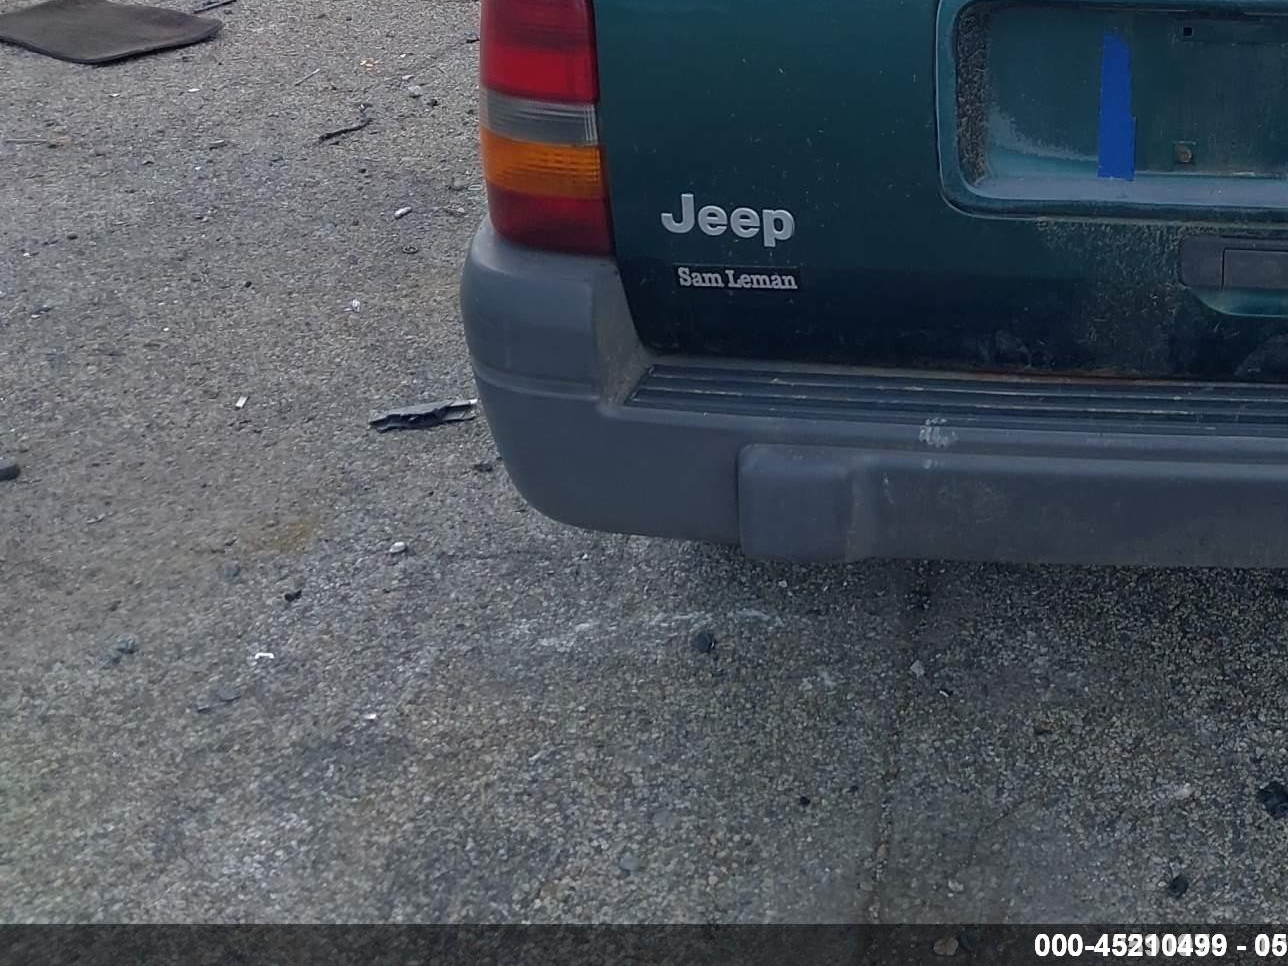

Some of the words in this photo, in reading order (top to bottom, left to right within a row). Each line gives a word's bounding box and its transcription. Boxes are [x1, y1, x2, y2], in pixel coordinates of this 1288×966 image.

[660, 193, 795, 247] Jeep
[677, 267, 724, 287] Sam
[725, 269, 798, 290] Leman
